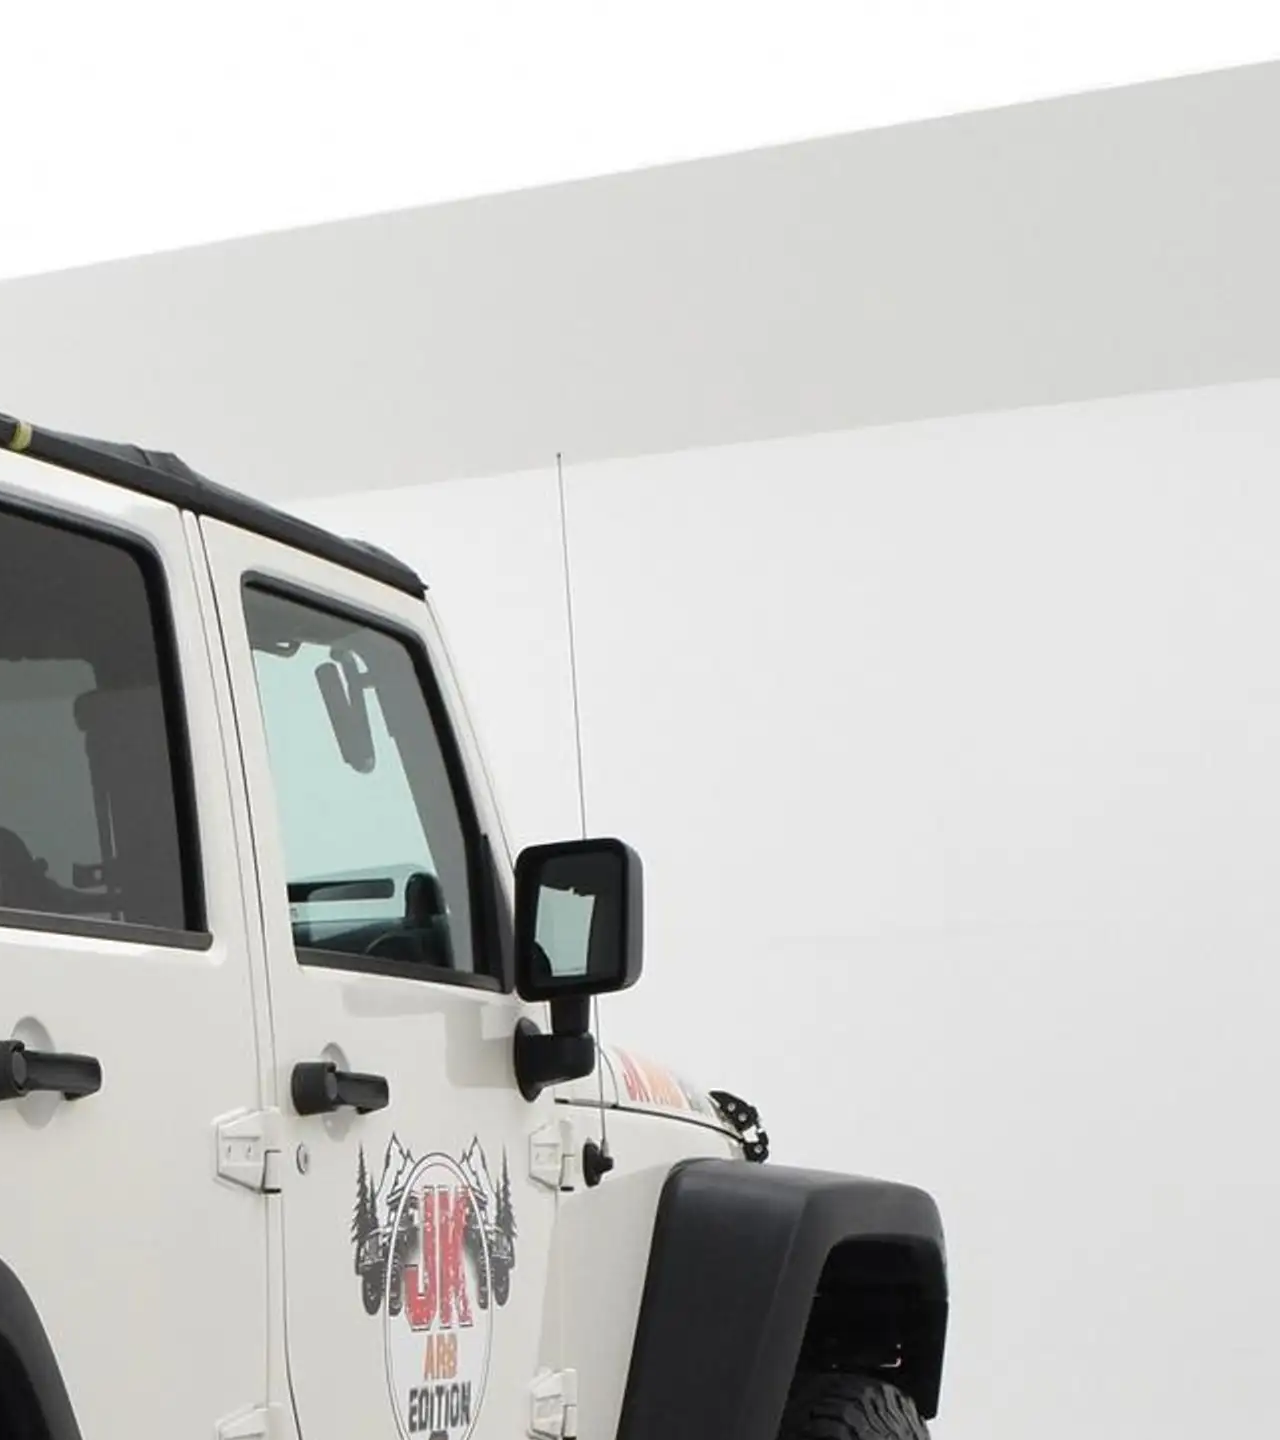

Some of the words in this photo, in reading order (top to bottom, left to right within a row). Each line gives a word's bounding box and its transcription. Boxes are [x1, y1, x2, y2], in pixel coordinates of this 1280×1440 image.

[403, 1185, 474, 1332] JK
[423, 1333, 459, 1381] ARB
[408, 1380, 472, 1434] EDITION
